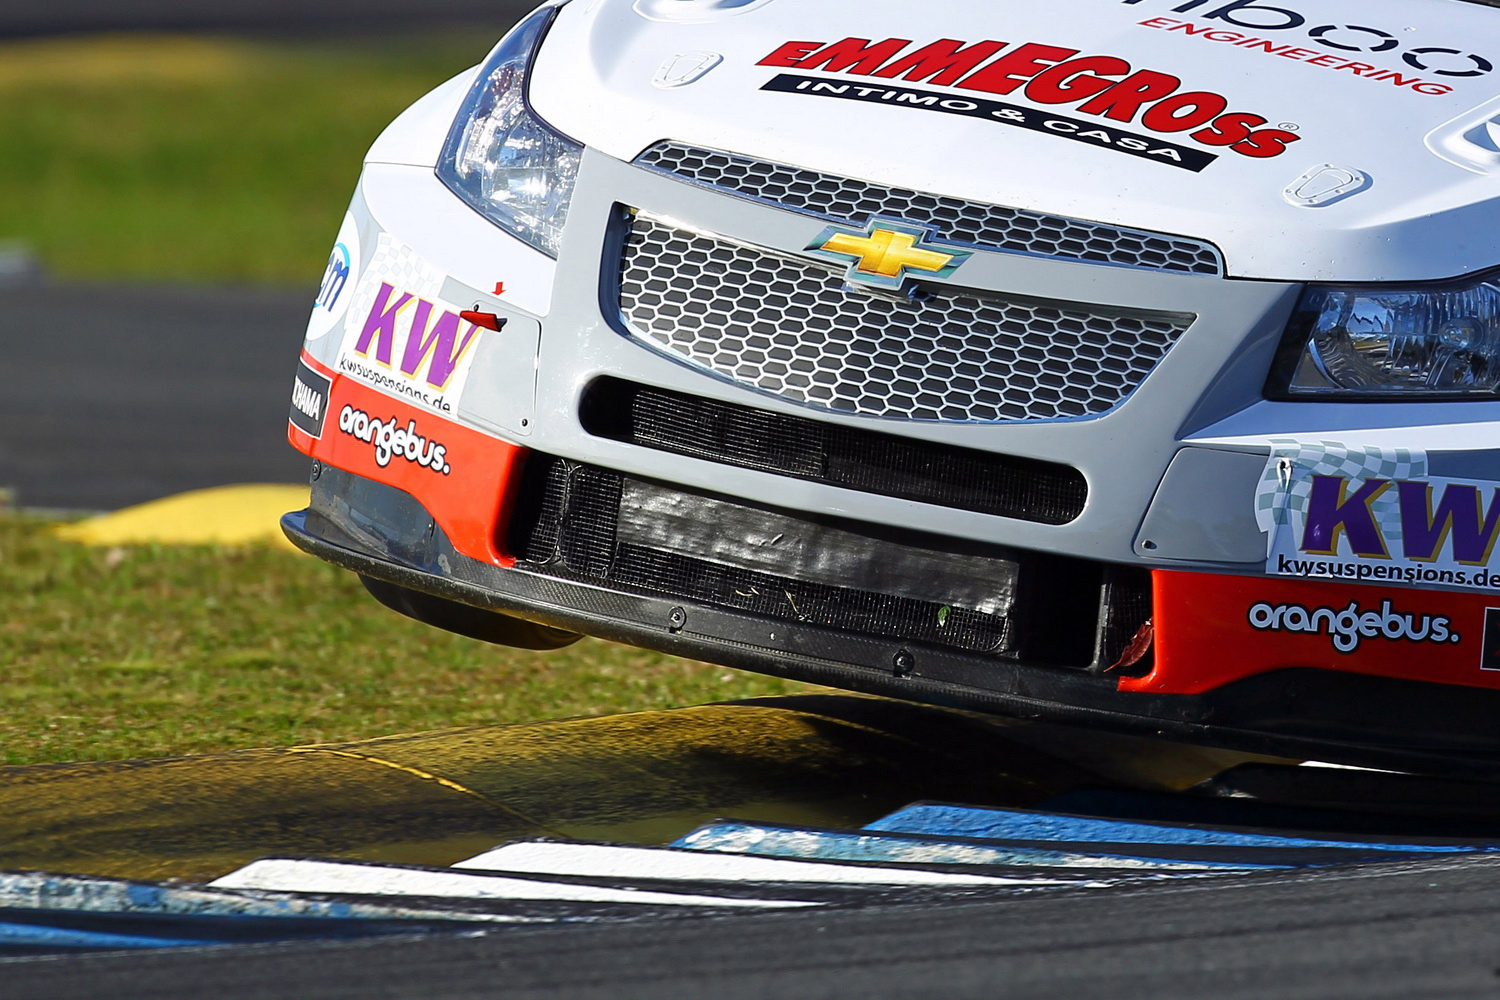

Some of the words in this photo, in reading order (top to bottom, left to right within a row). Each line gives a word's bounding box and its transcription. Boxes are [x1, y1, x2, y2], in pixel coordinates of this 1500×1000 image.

[1136, 15, 1455, 99] ENGINEERING
[795, 79, 975, 111] INTIMO
[991, 108, 1026, 122] &
[1042, 118, 1183, 164] CASA
[354, 280, 483, 393] KW
